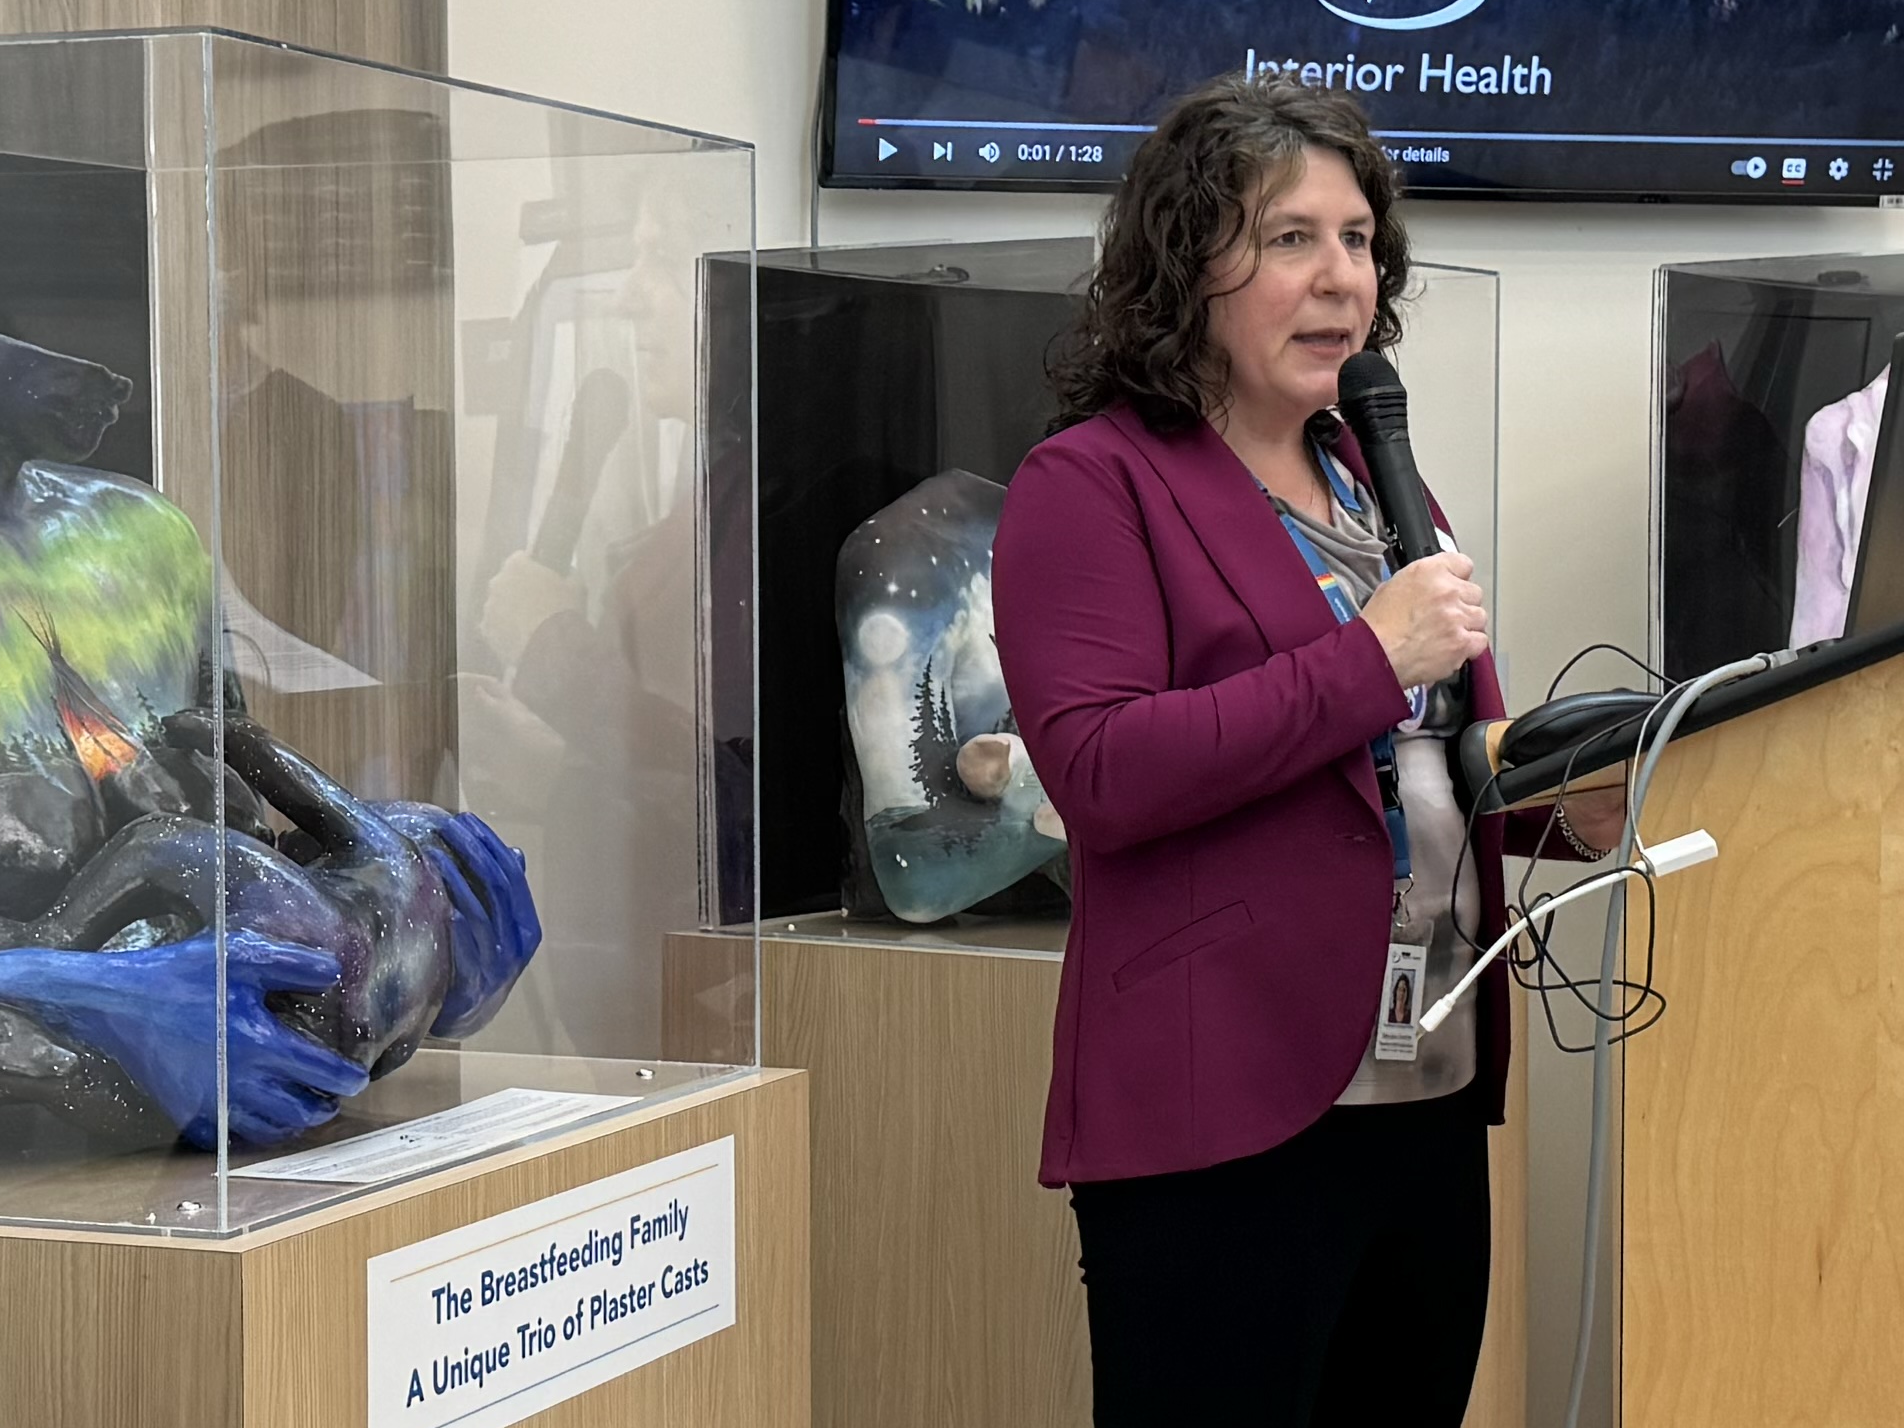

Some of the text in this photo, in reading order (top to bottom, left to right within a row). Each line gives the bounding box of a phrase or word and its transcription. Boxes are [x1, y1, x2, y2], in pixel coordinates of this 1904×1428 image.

[1419, 53, 1551, 95] Health
[1018, 143, 1103, 163] 0:01 / 1:28
[1403, 146, 1450, 163] details
[431, 1197, 690, 1325] The Breastfeeding Family
[406, 1257, 710, 1408] A Unique Trio of Plaster Casts
